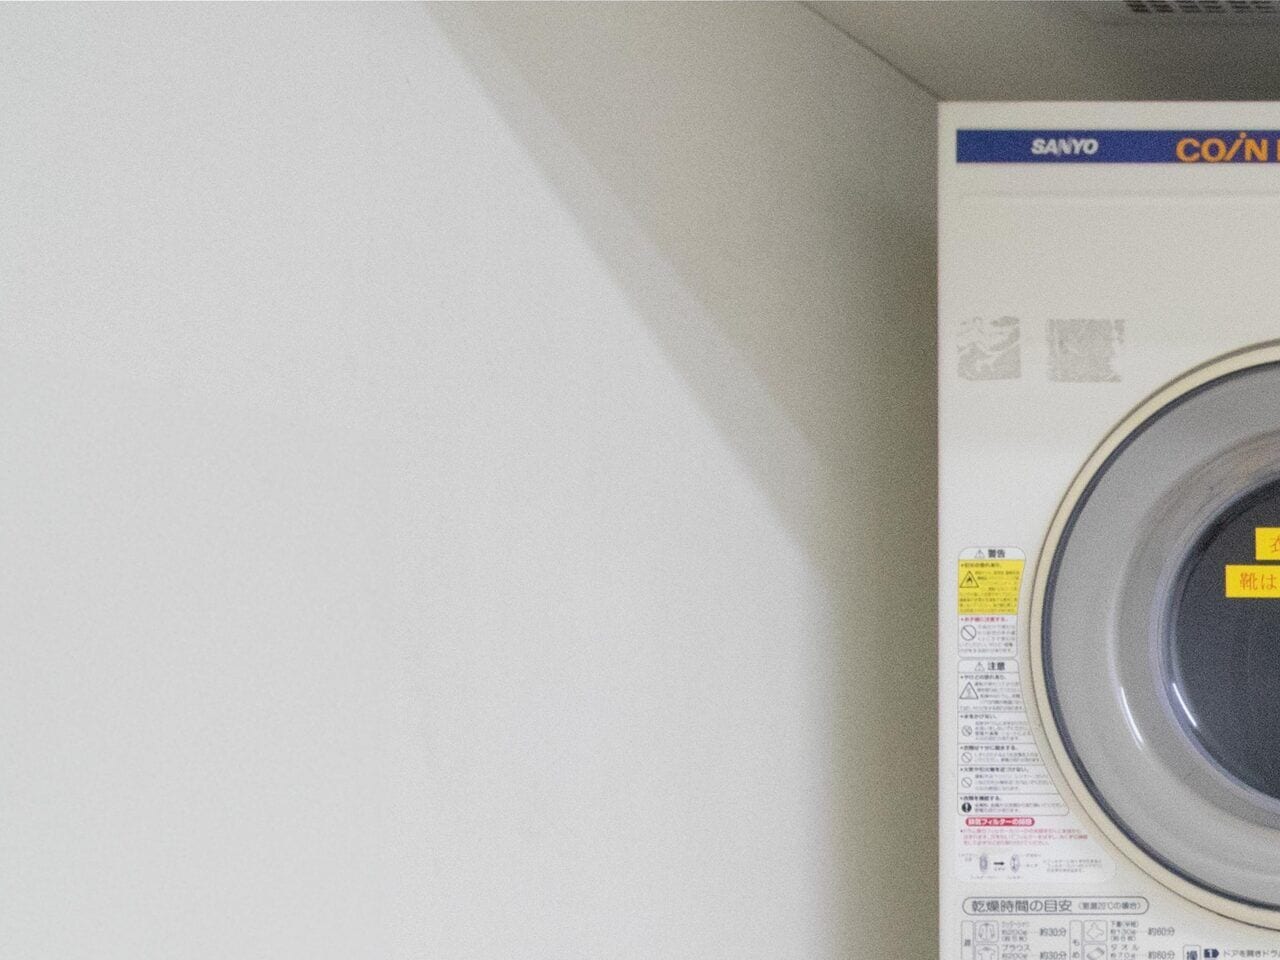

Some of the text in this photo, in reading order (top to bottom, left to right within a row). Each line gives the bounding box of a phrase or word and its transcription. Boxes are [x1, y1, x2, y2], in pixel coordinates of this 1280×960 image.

[1031, 138, 1098, 156] SANYO
[988, 662, 1005, 671] 注意
[971, 899, 1072, 912] 乾燥時間の目安
